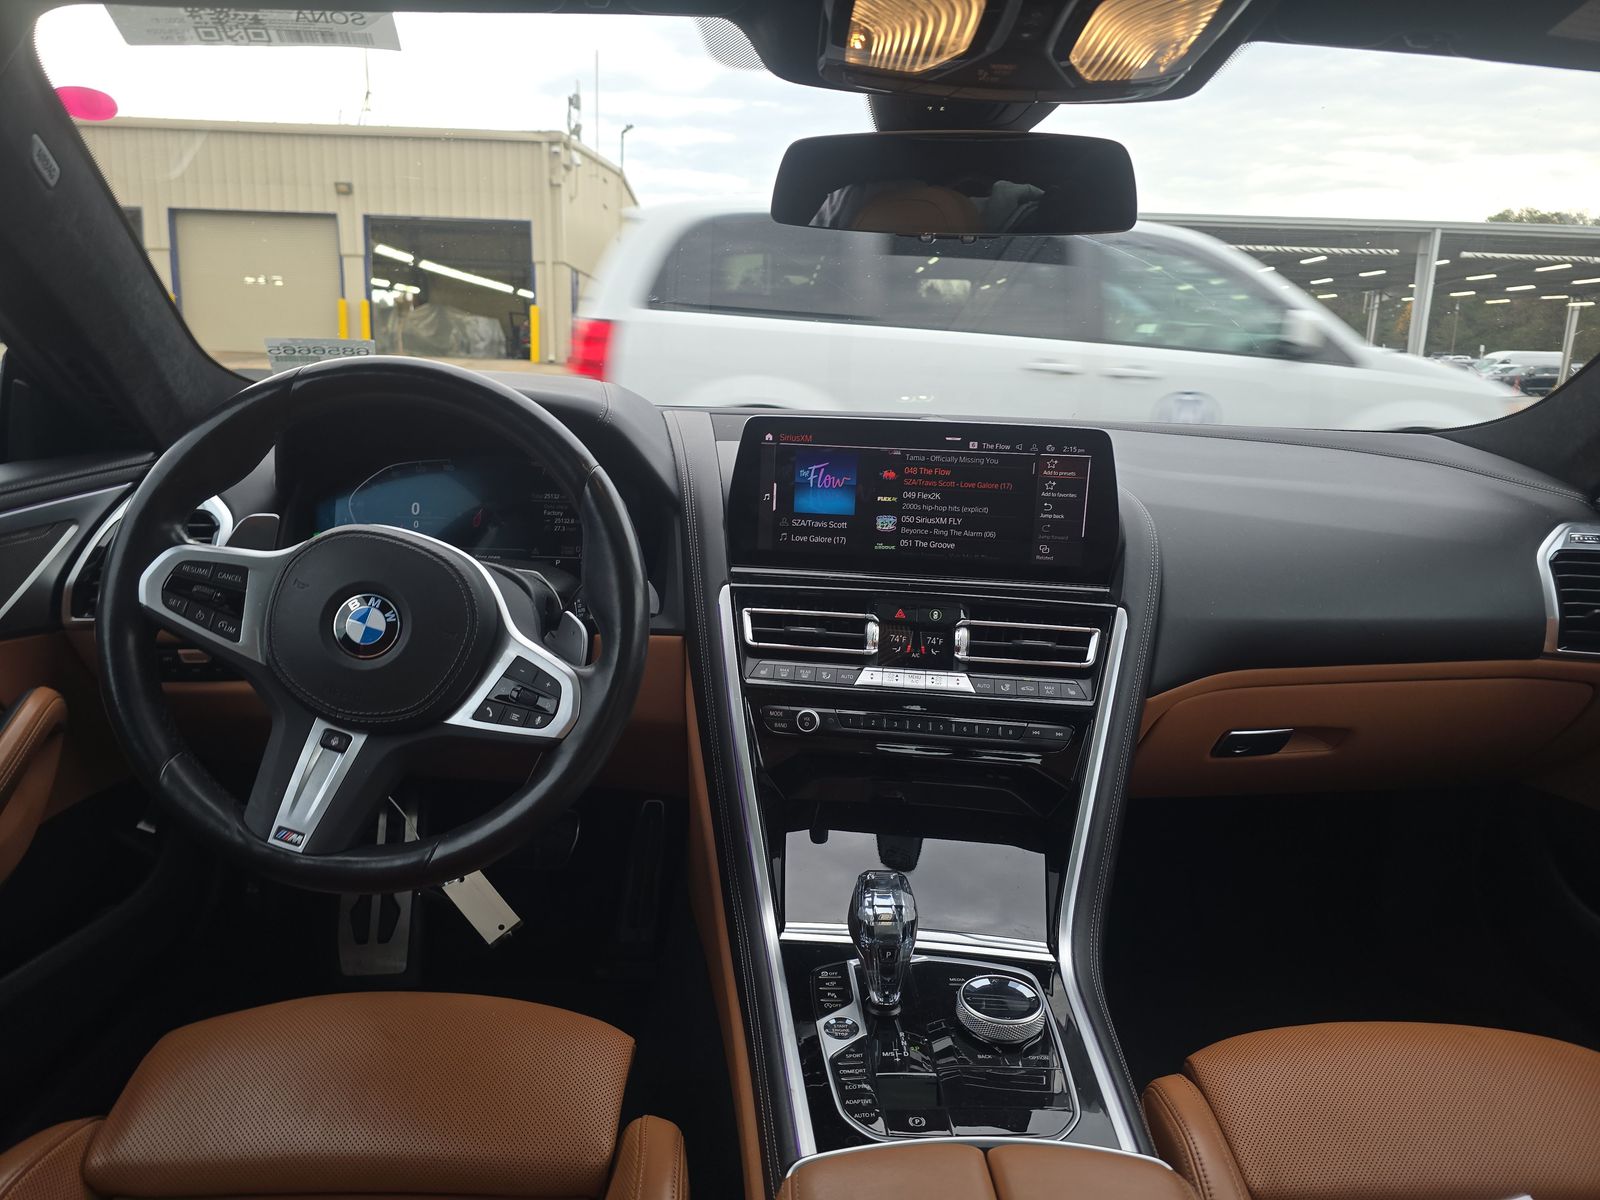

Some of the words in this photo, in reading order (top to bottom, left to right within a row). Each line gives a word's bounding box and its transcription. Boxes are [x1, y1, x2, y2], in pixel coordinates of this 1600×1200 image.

[780, 434, 812, 442] SiriusXM
[930, 455, 958, 464] Officially
[959, 456, 984, 465] Missing
[808, 462, 850, 488] Flow
[411, 502, 420, 516] 0
[922, 504, 947, 512] hip-hop
[961, 506, 988, 514] (explicit)
[791, 519, 828, 528] SZA/Travis
[828, 520, 847, 529] Scott
[984, 531, 996, 539] (06)
[809, 536, 832, 544] Galore
[833, 536, 846, 545] (17)
[930, 541, 955, 549] Groove
[182, 564, 208, 575] RESUME
[218, 572, 241, 582] CANCEL
[169, 598, 180, 607] SET
[347, 596, 396, 622] BMW
